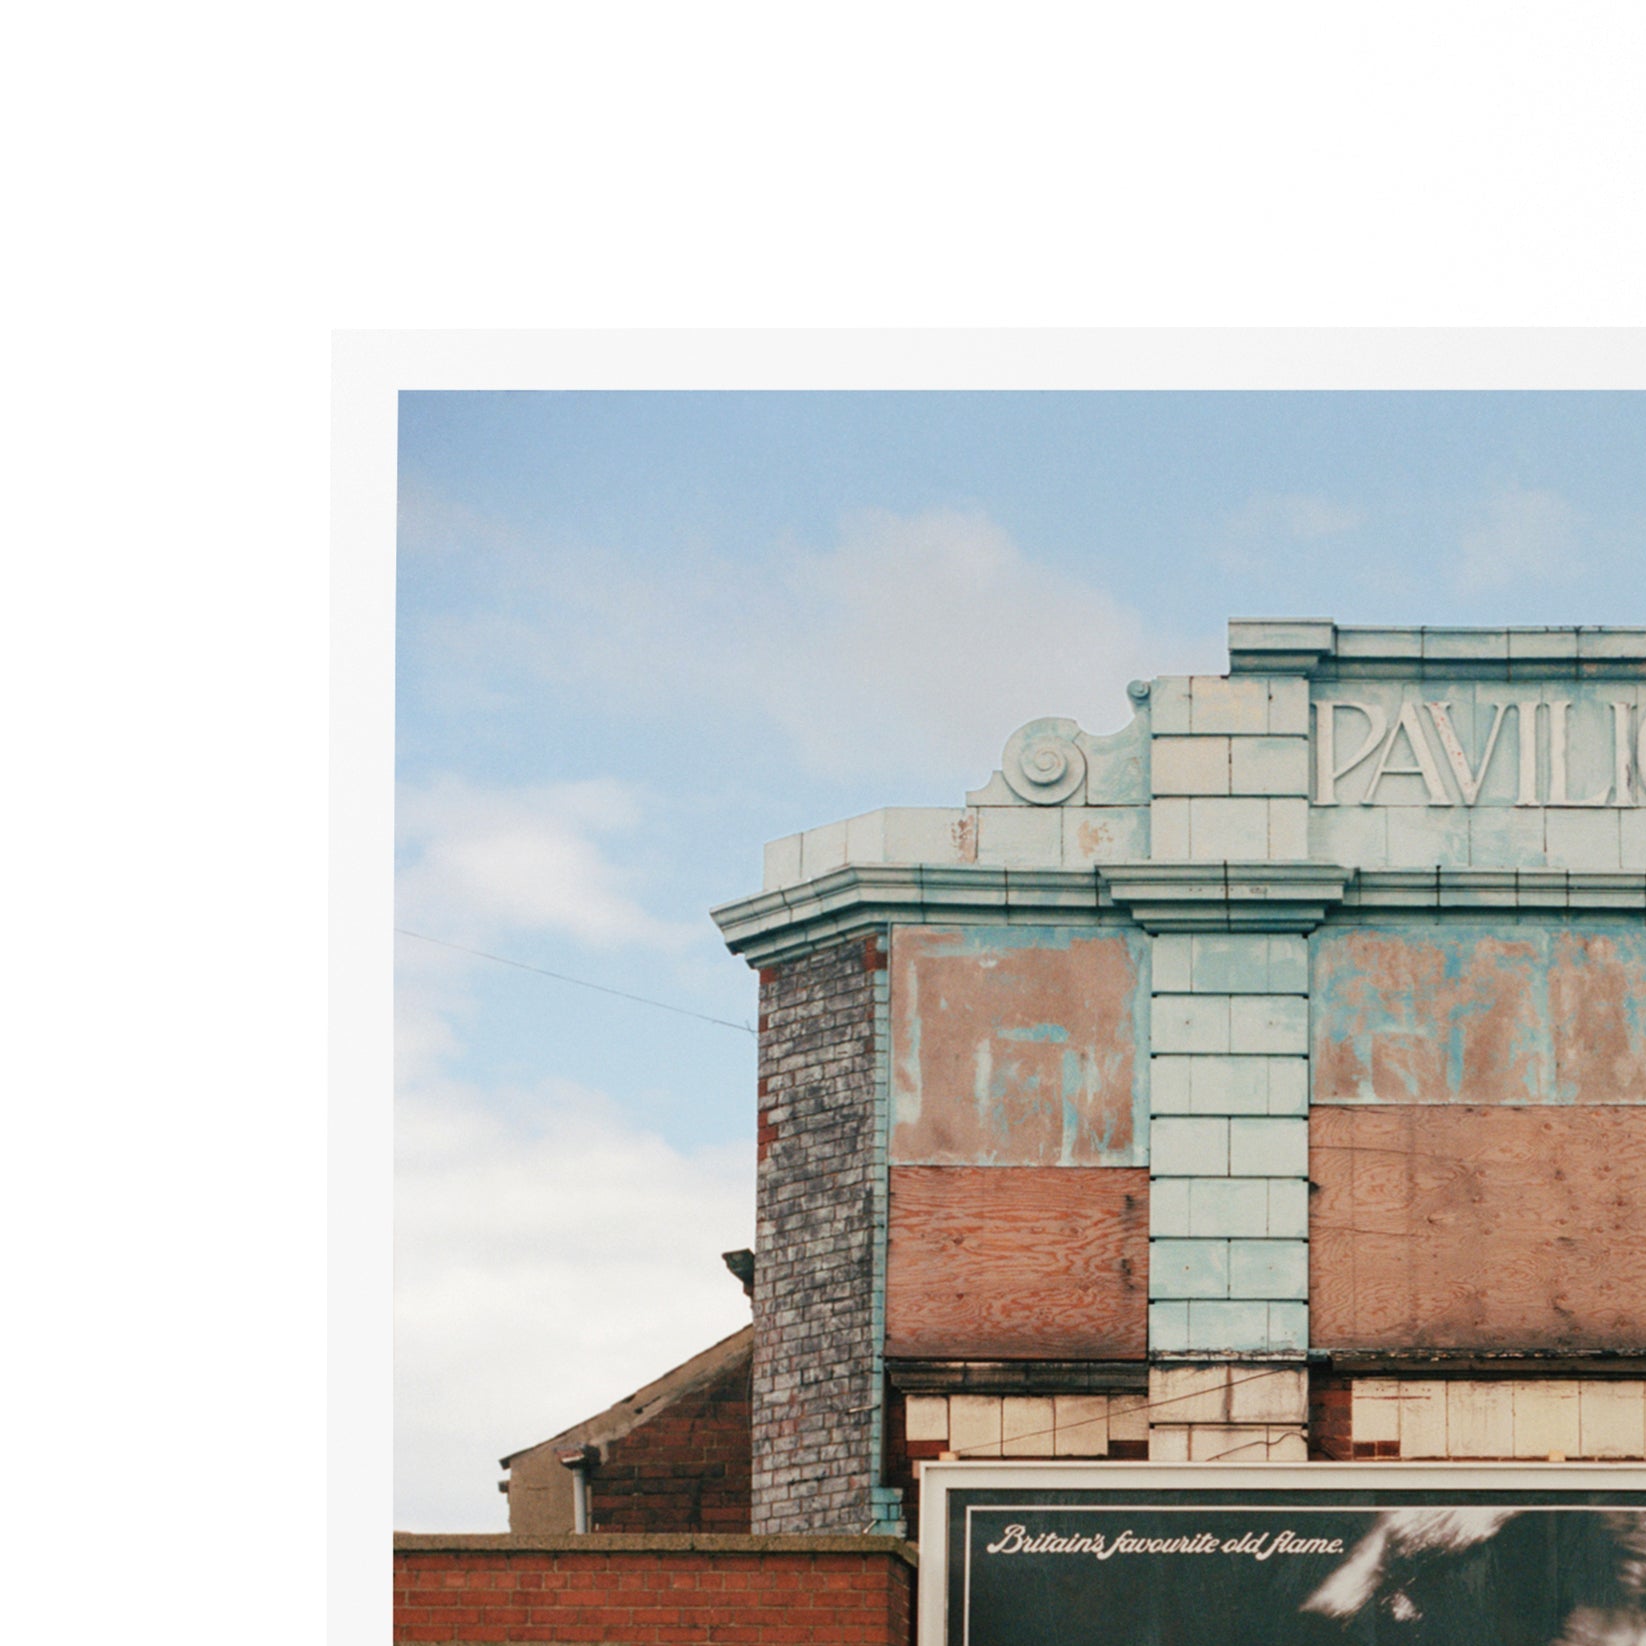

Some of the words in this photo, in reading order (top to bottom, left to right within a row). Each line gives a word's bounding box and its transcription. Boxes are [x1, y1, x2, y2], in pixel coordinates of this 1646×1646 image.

[987, 1524, 1105, 1554] Britain's
[1097, 1530, 1219, 1560] favourite
[1221, 1532, 1268, 1554] old
[1255, 1530, 1344, 1561] flame.
